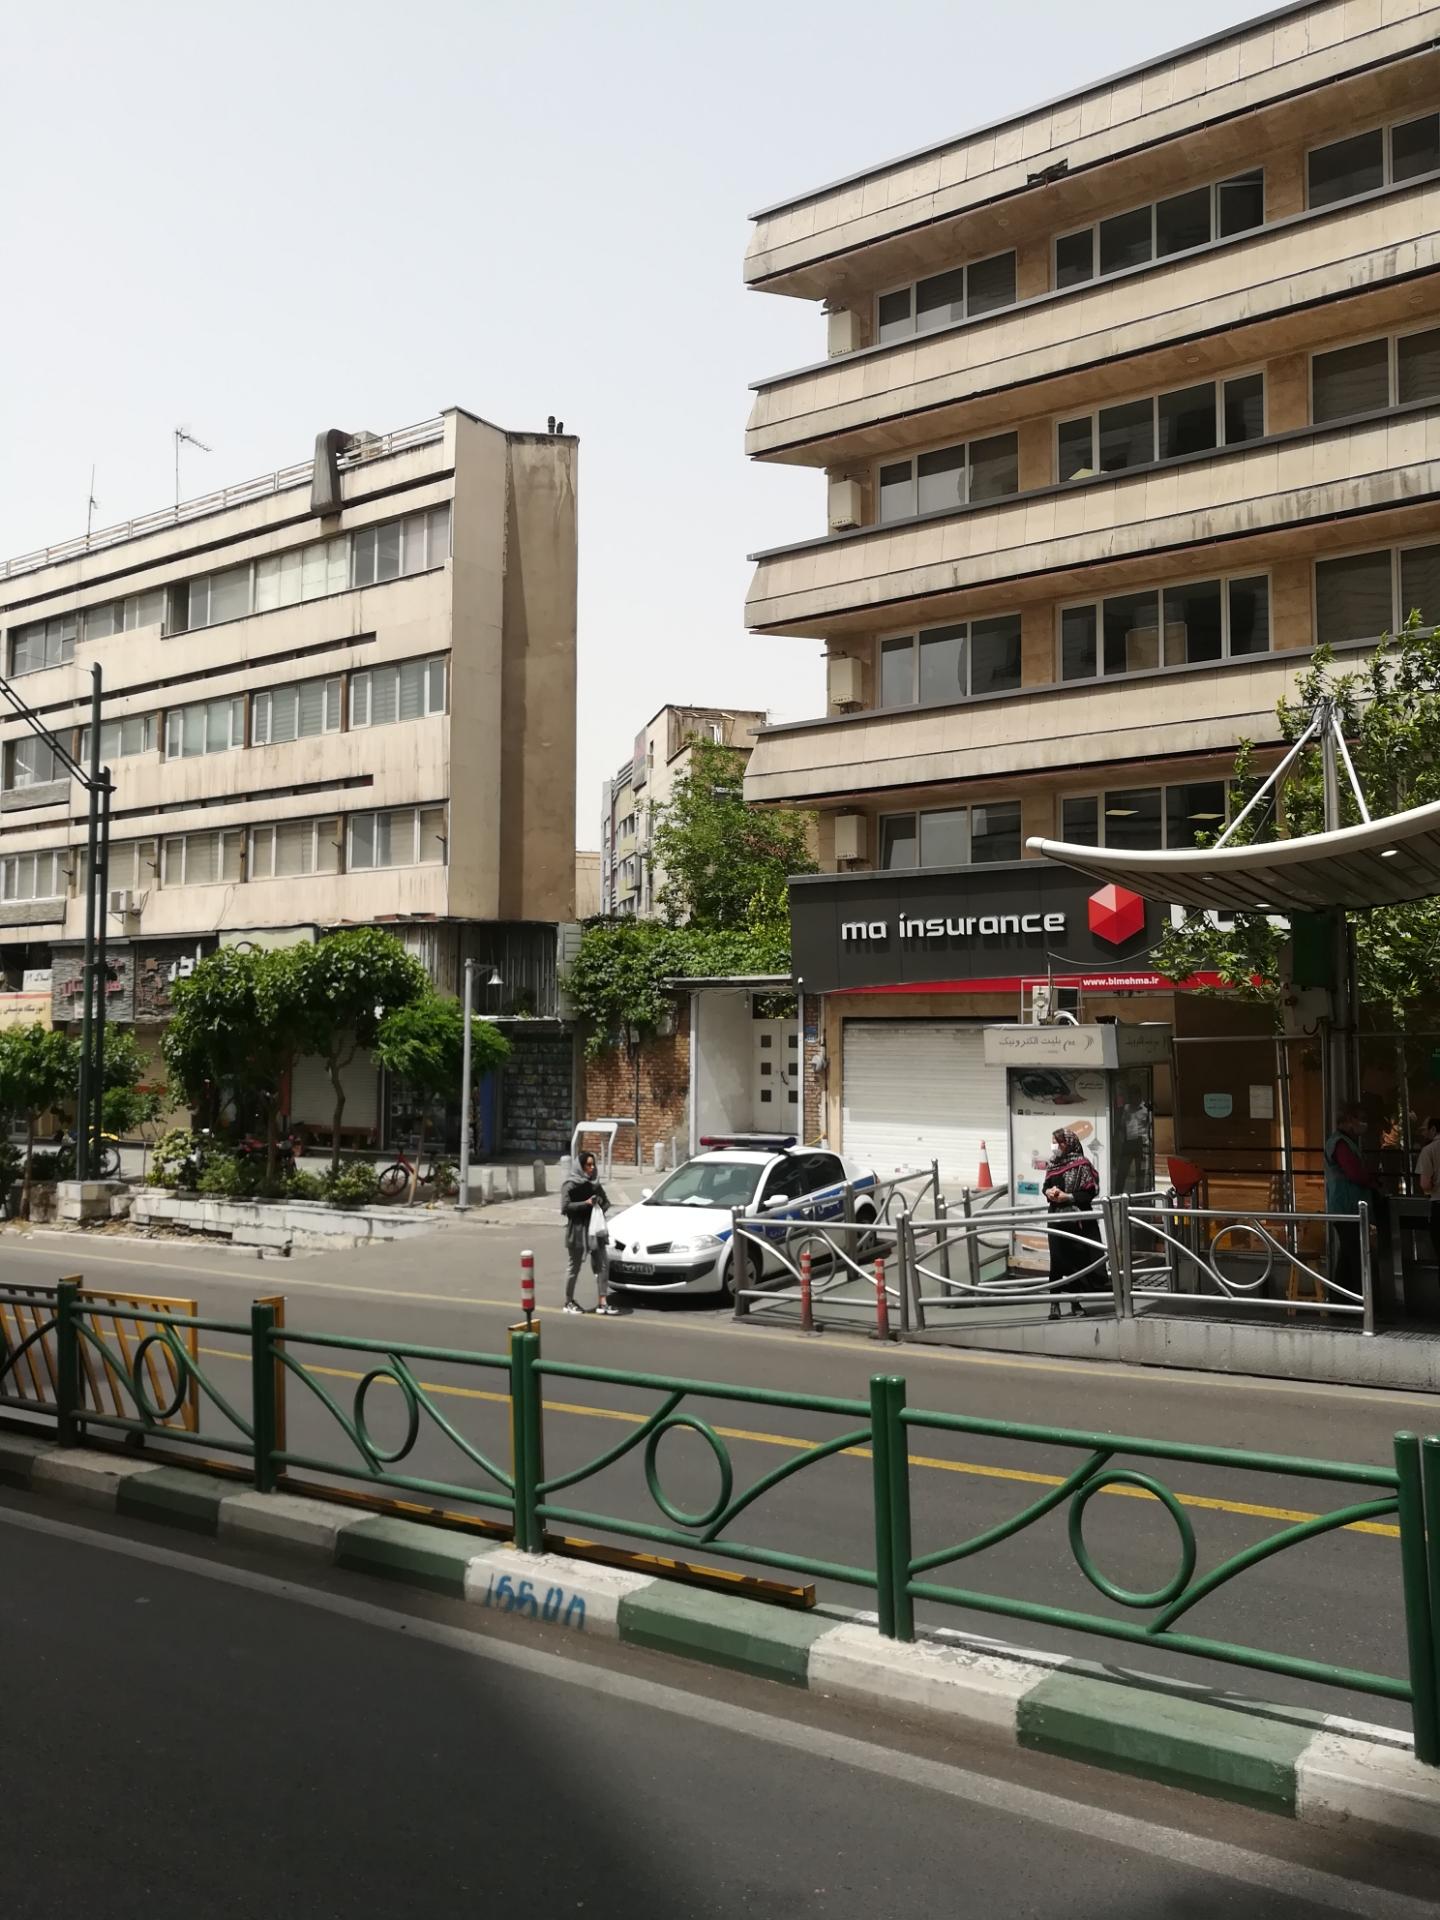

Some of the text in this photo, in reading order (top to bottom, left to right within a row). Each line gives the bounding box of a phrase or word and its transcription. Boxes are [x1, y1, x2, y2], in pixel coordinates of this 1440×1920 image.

[841, 912, 1066, 940] ma insurance
[1083, 976, 1159, 986] www.bimehma.ir
